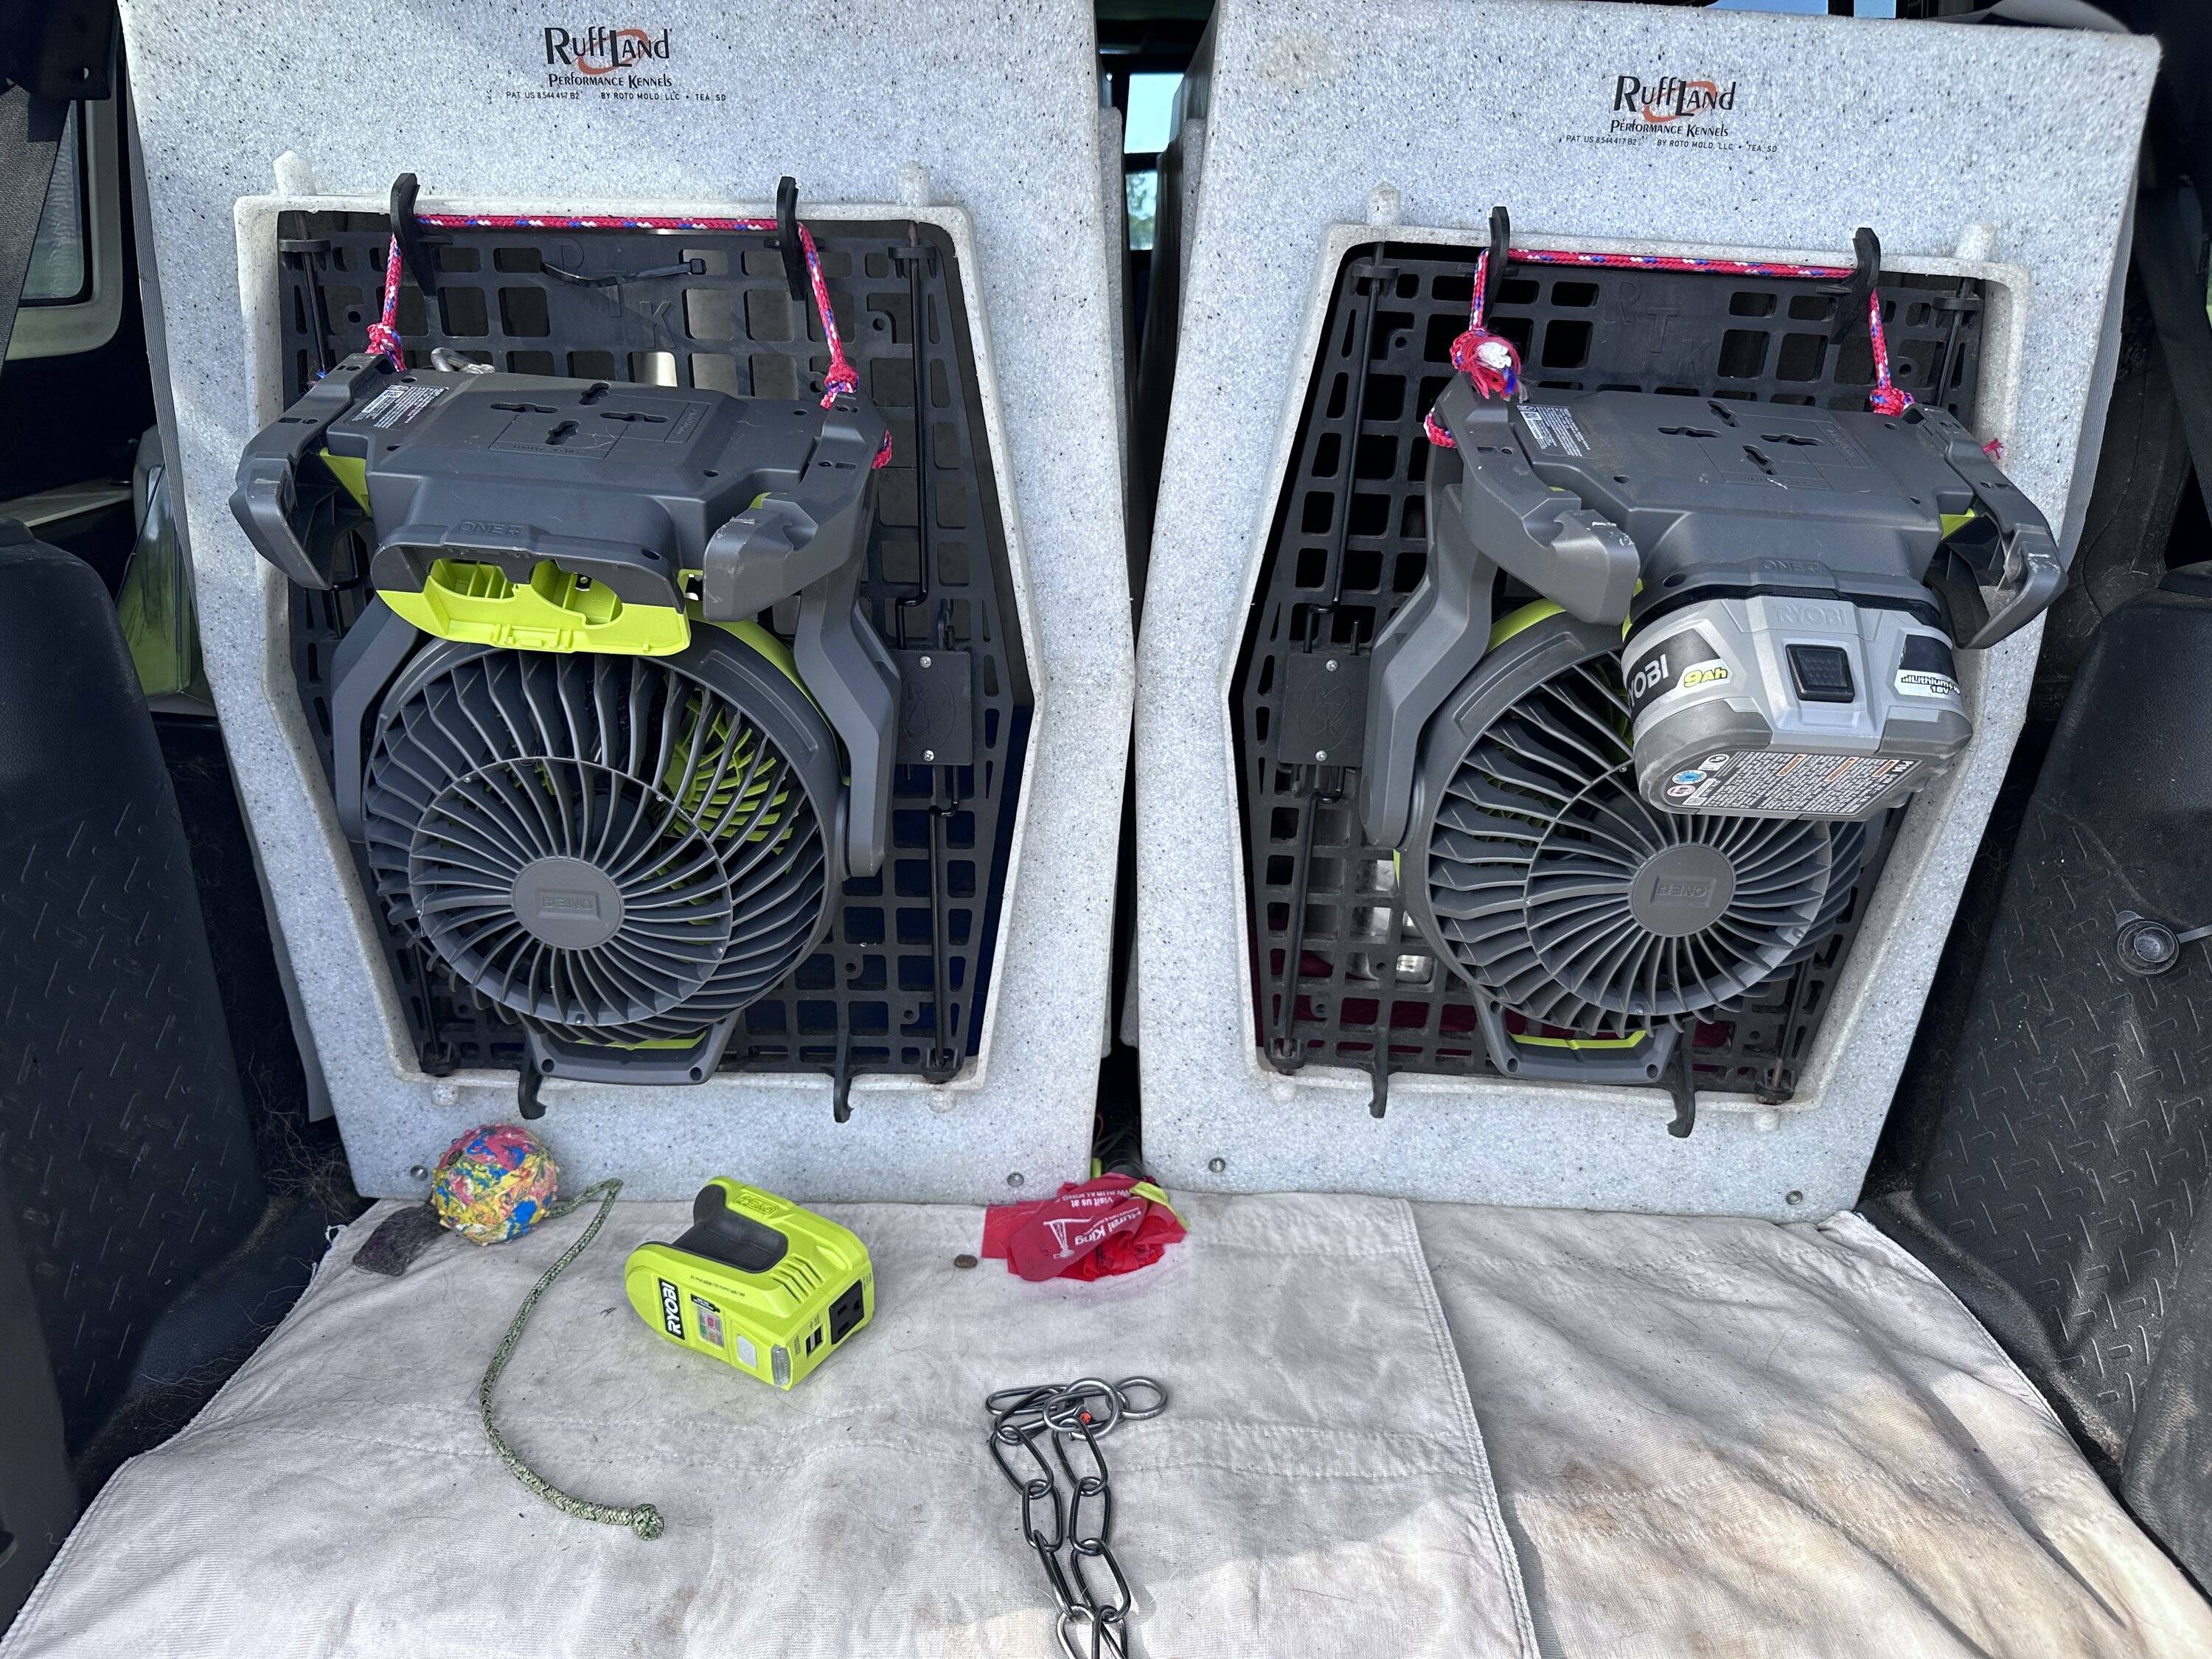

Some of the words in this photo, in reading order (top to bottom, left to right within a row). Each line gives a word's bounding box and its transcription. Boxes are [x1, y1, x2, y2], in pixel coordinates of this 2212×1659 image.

[524, 91, 535, 100] US
[570, 91, 580, 100] B2
[613, 92, 634, 100] ROTO
[1669, 140, 1689, 148] ROTO
[1718, 142, 1733, 150] LLC
[1773, 603, 1848, 626] RYOBI
[1628, 653, 1669, 707] YOBI
[1683, 667, 1728, 688] 9Ah
[1930, 684, 1950, 695] 18V
[1071, 1199, 1079, 1208] at
[1082, 1198, 1092, 1206] us
[1093, 1197, 1113, 1207] Visit
[1074, 1225, 1106, 1245] King
[661, 1280, 683, 1335] RYOBI
